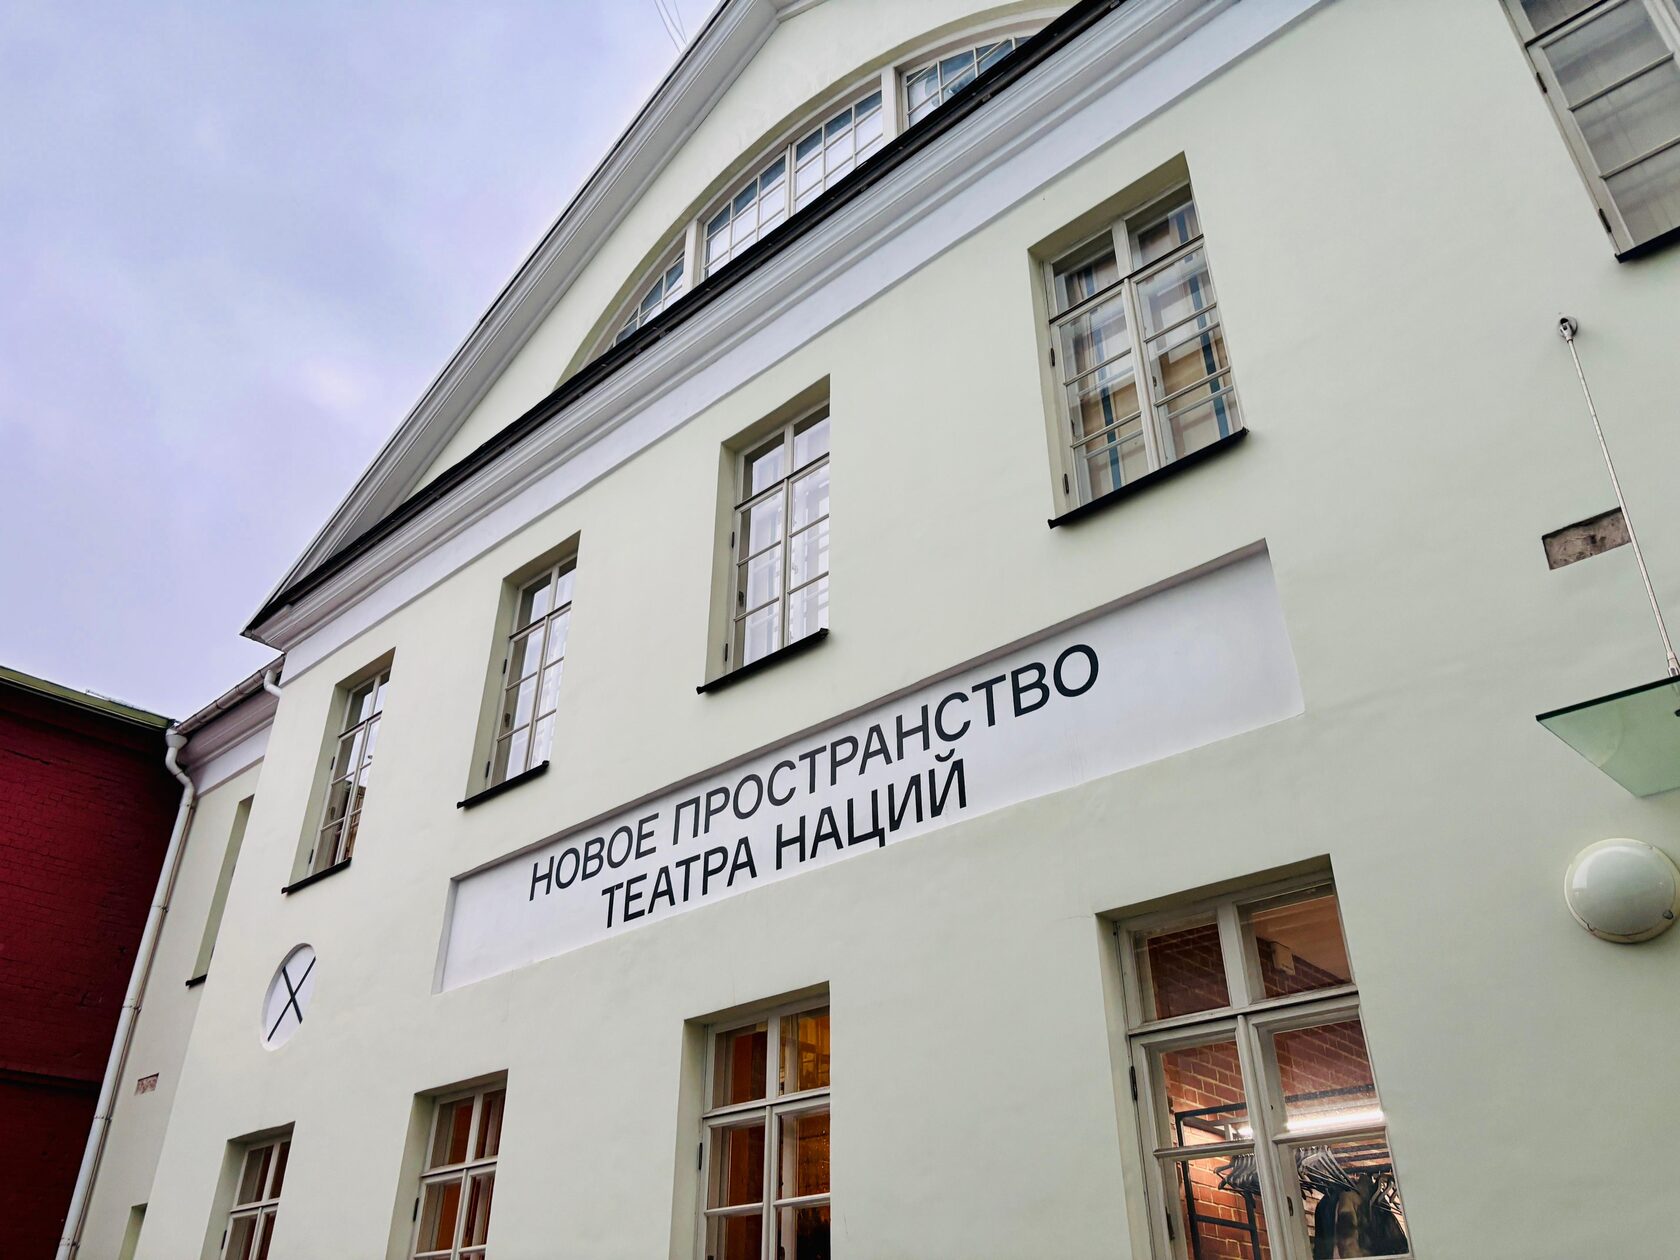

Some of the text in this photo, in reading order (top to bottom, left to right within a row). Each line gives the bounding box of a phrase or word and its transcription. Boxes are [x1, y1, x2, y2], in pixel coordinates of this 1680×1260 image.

[530, 644, 1099, 902] НОВОЕ ПРОСТРАНСТВО
[601, 747, 967, 929] ТЕАТРА НАЦИЙ
